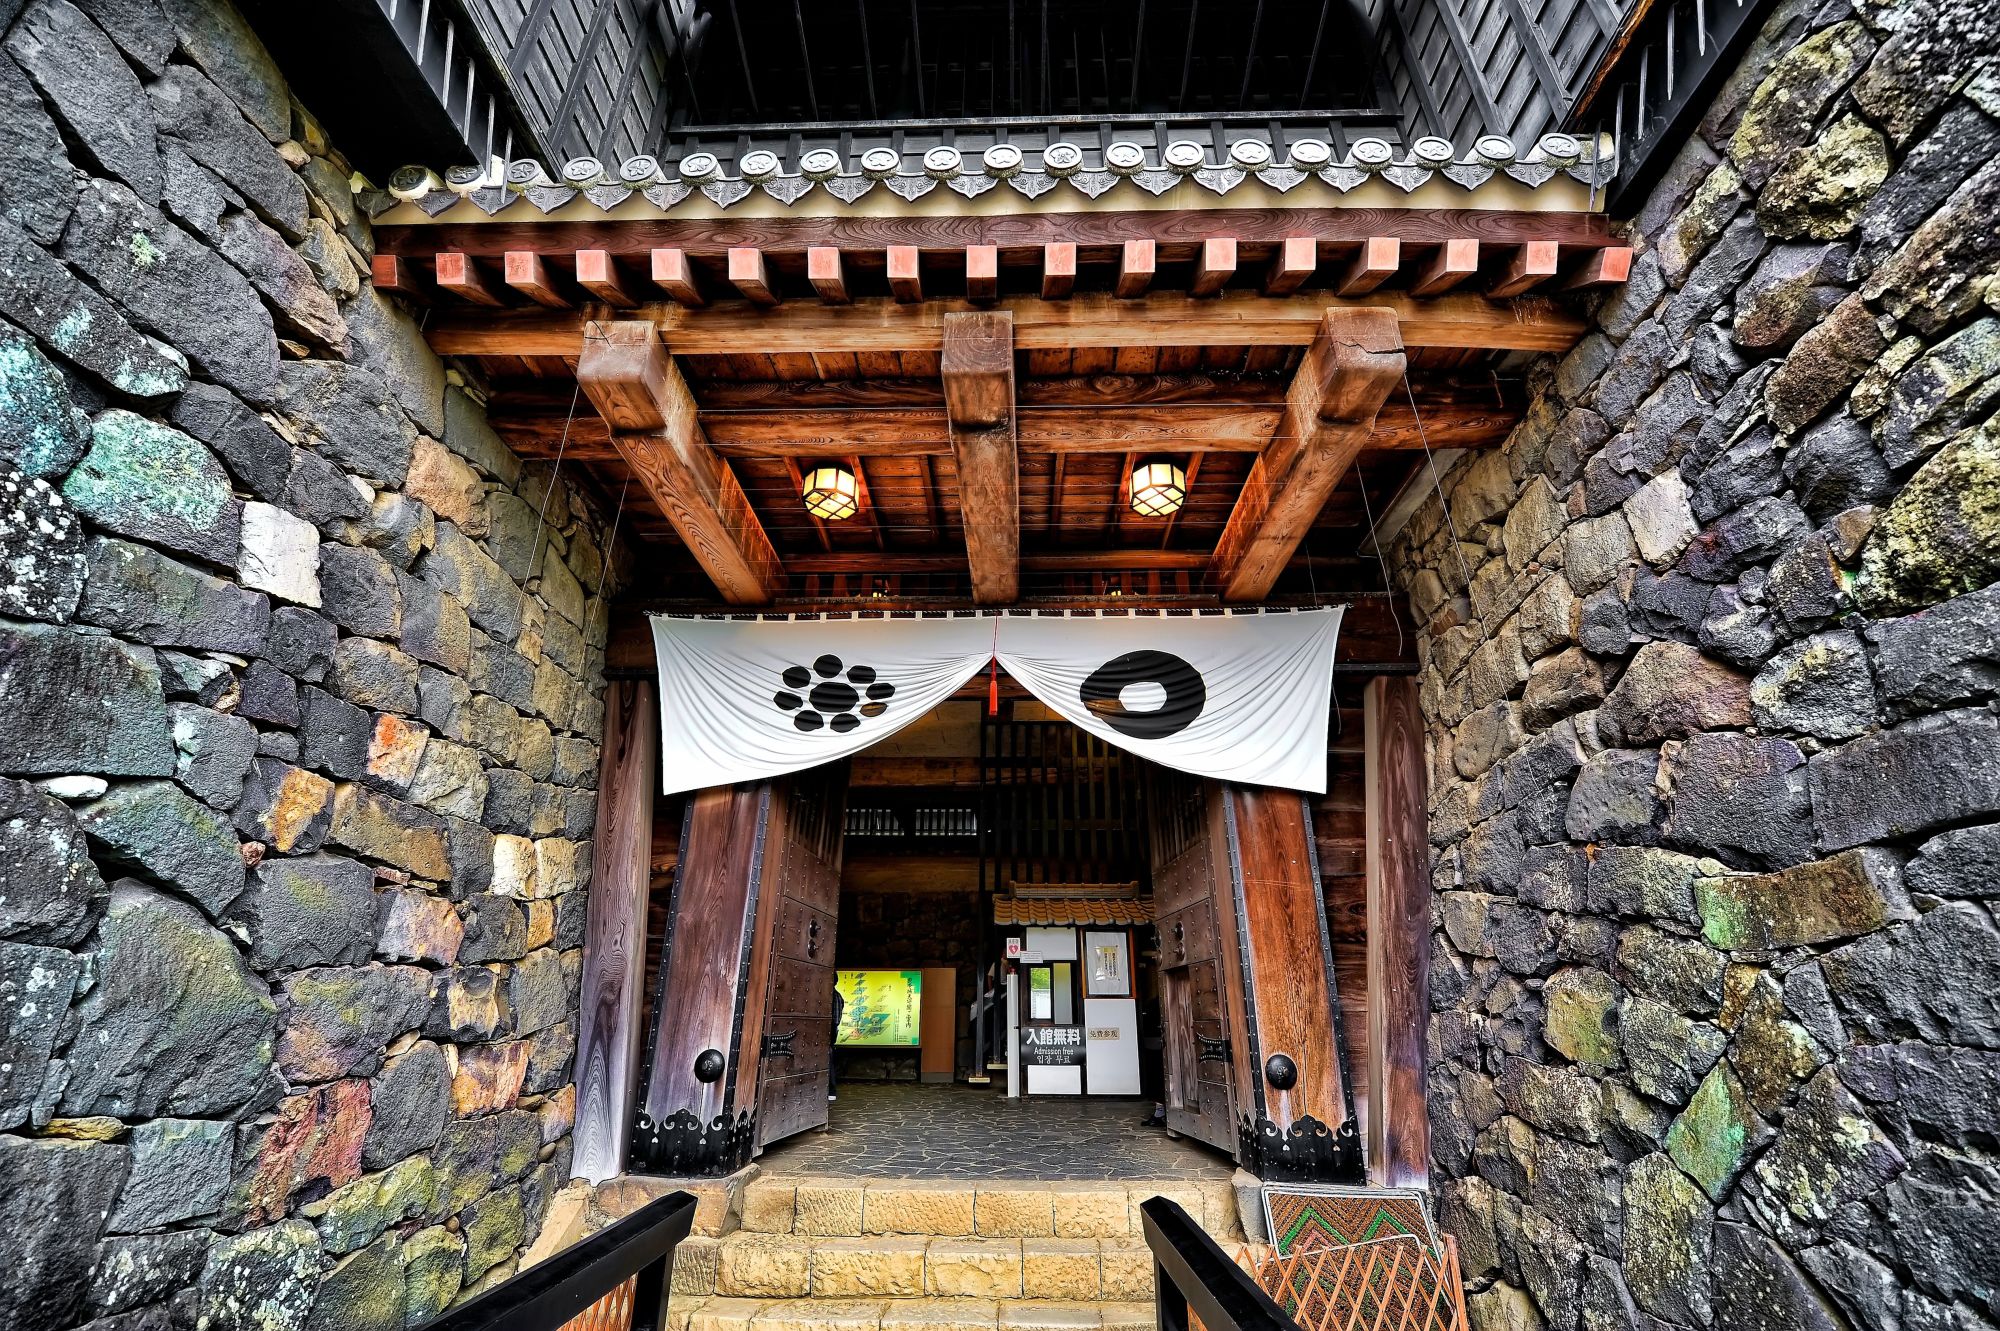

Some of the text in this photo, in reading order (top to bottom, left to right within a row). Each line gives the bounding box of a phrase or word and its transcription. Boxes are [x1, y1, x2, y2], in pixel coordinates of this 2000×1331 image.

[1026, 1028, 1081, 1045] 入館無料
[1034, 1047, 1074, 1055] Admission free
[1037, 1055, 1071, 1064] 입장 무료
